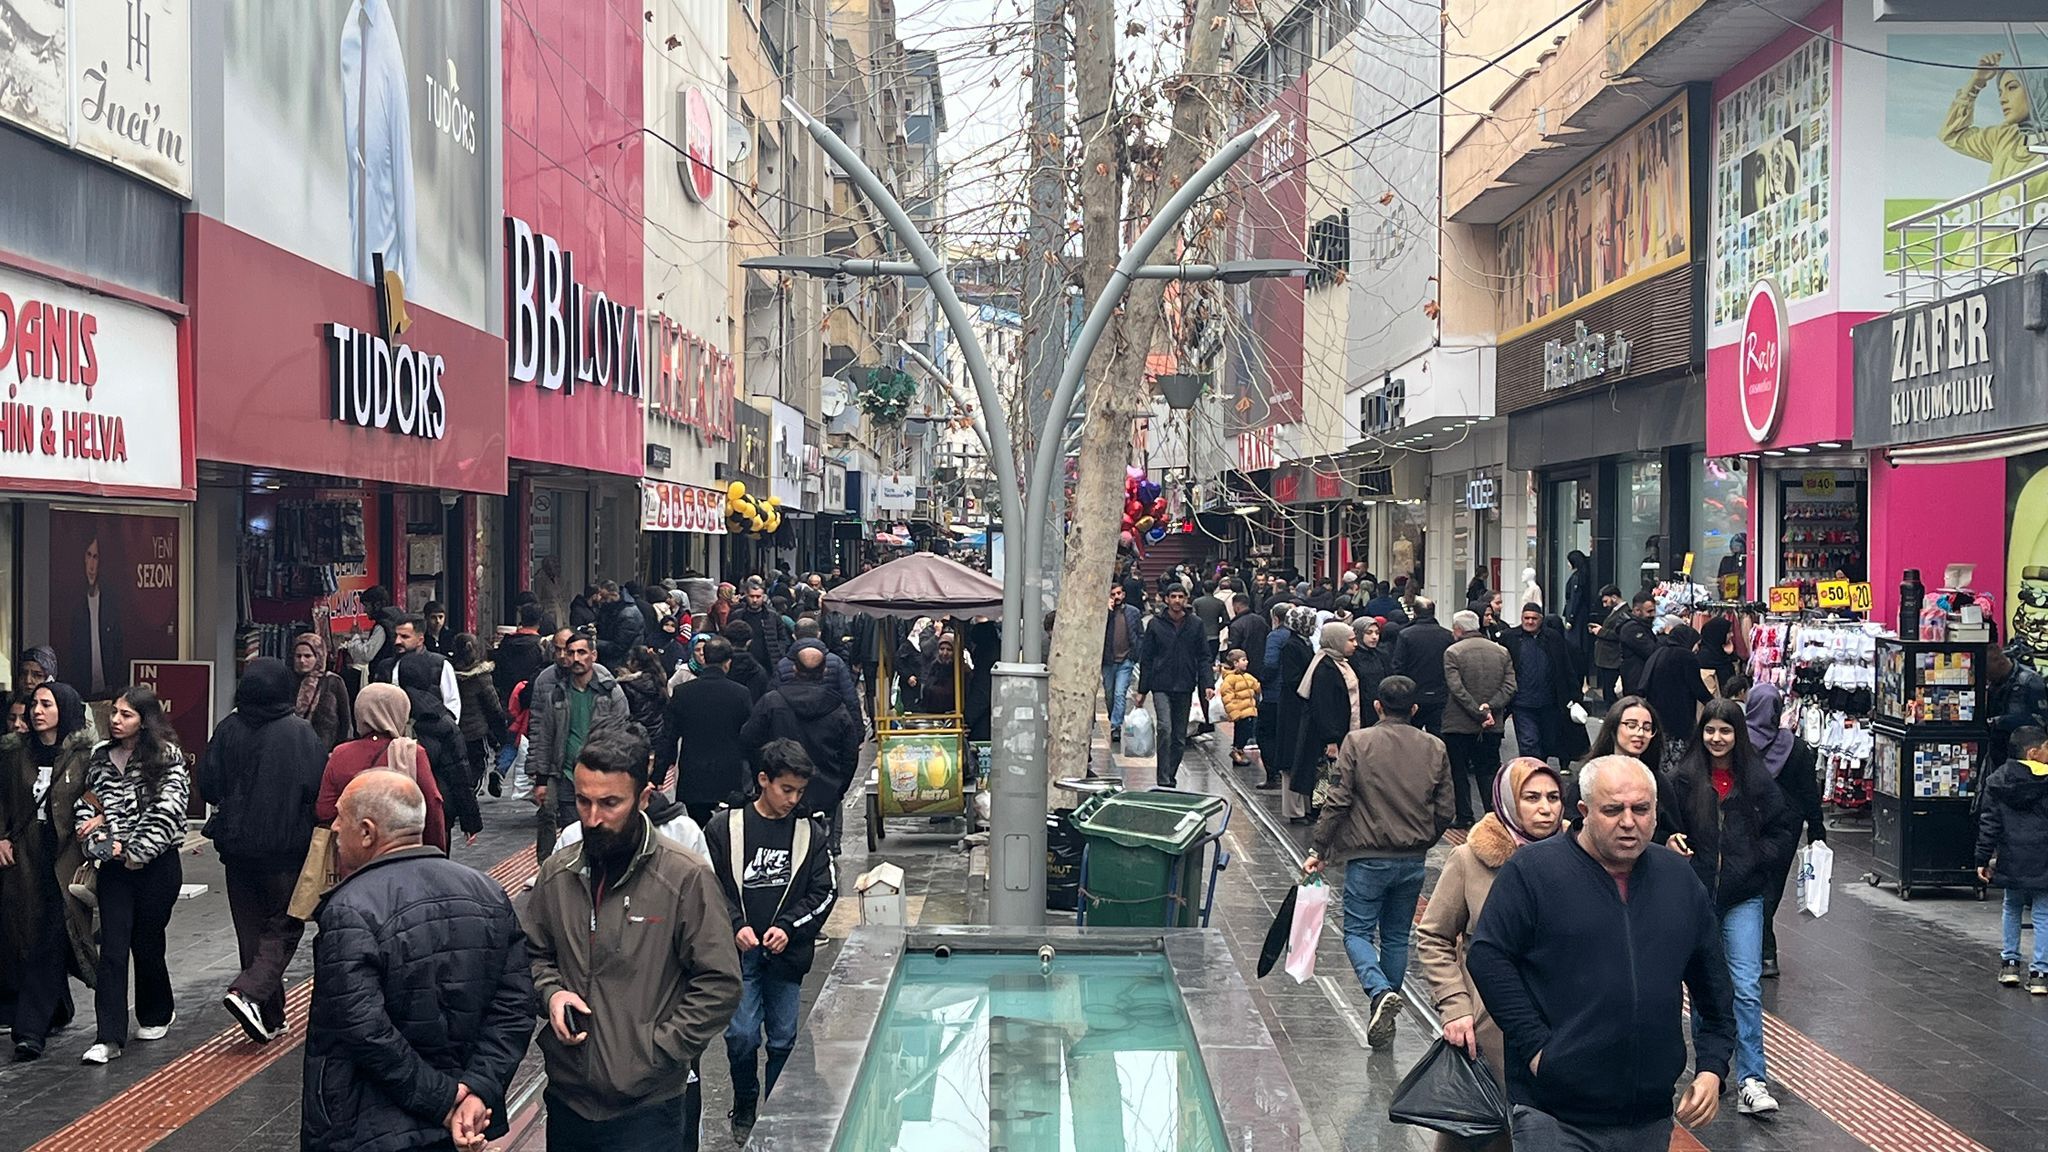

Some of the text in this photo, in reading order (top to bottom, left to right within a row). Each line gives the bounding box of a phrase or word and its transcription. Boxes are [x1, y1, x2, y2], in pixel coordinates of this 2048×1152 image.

[426, 74, 476, 155] TUDORS
[1891, 294, 1990, 382] ZAFER
[329, 322, 446, 440] TUDORS
[1891, 374, 1994, 425] KUYUMCULUK
[41, 407, 56, 455] &
[63, 410, 128, 462] HELVA
[152, 532, 173, 559] YENİ
[137, 563, 173, 588] SEZON
[1782, 591, 1796, 606] 50
[1828, 585, 1844, 600] 50
[1856, 585, 1870, 608] 20
[140, 665, 157, 678] IN
